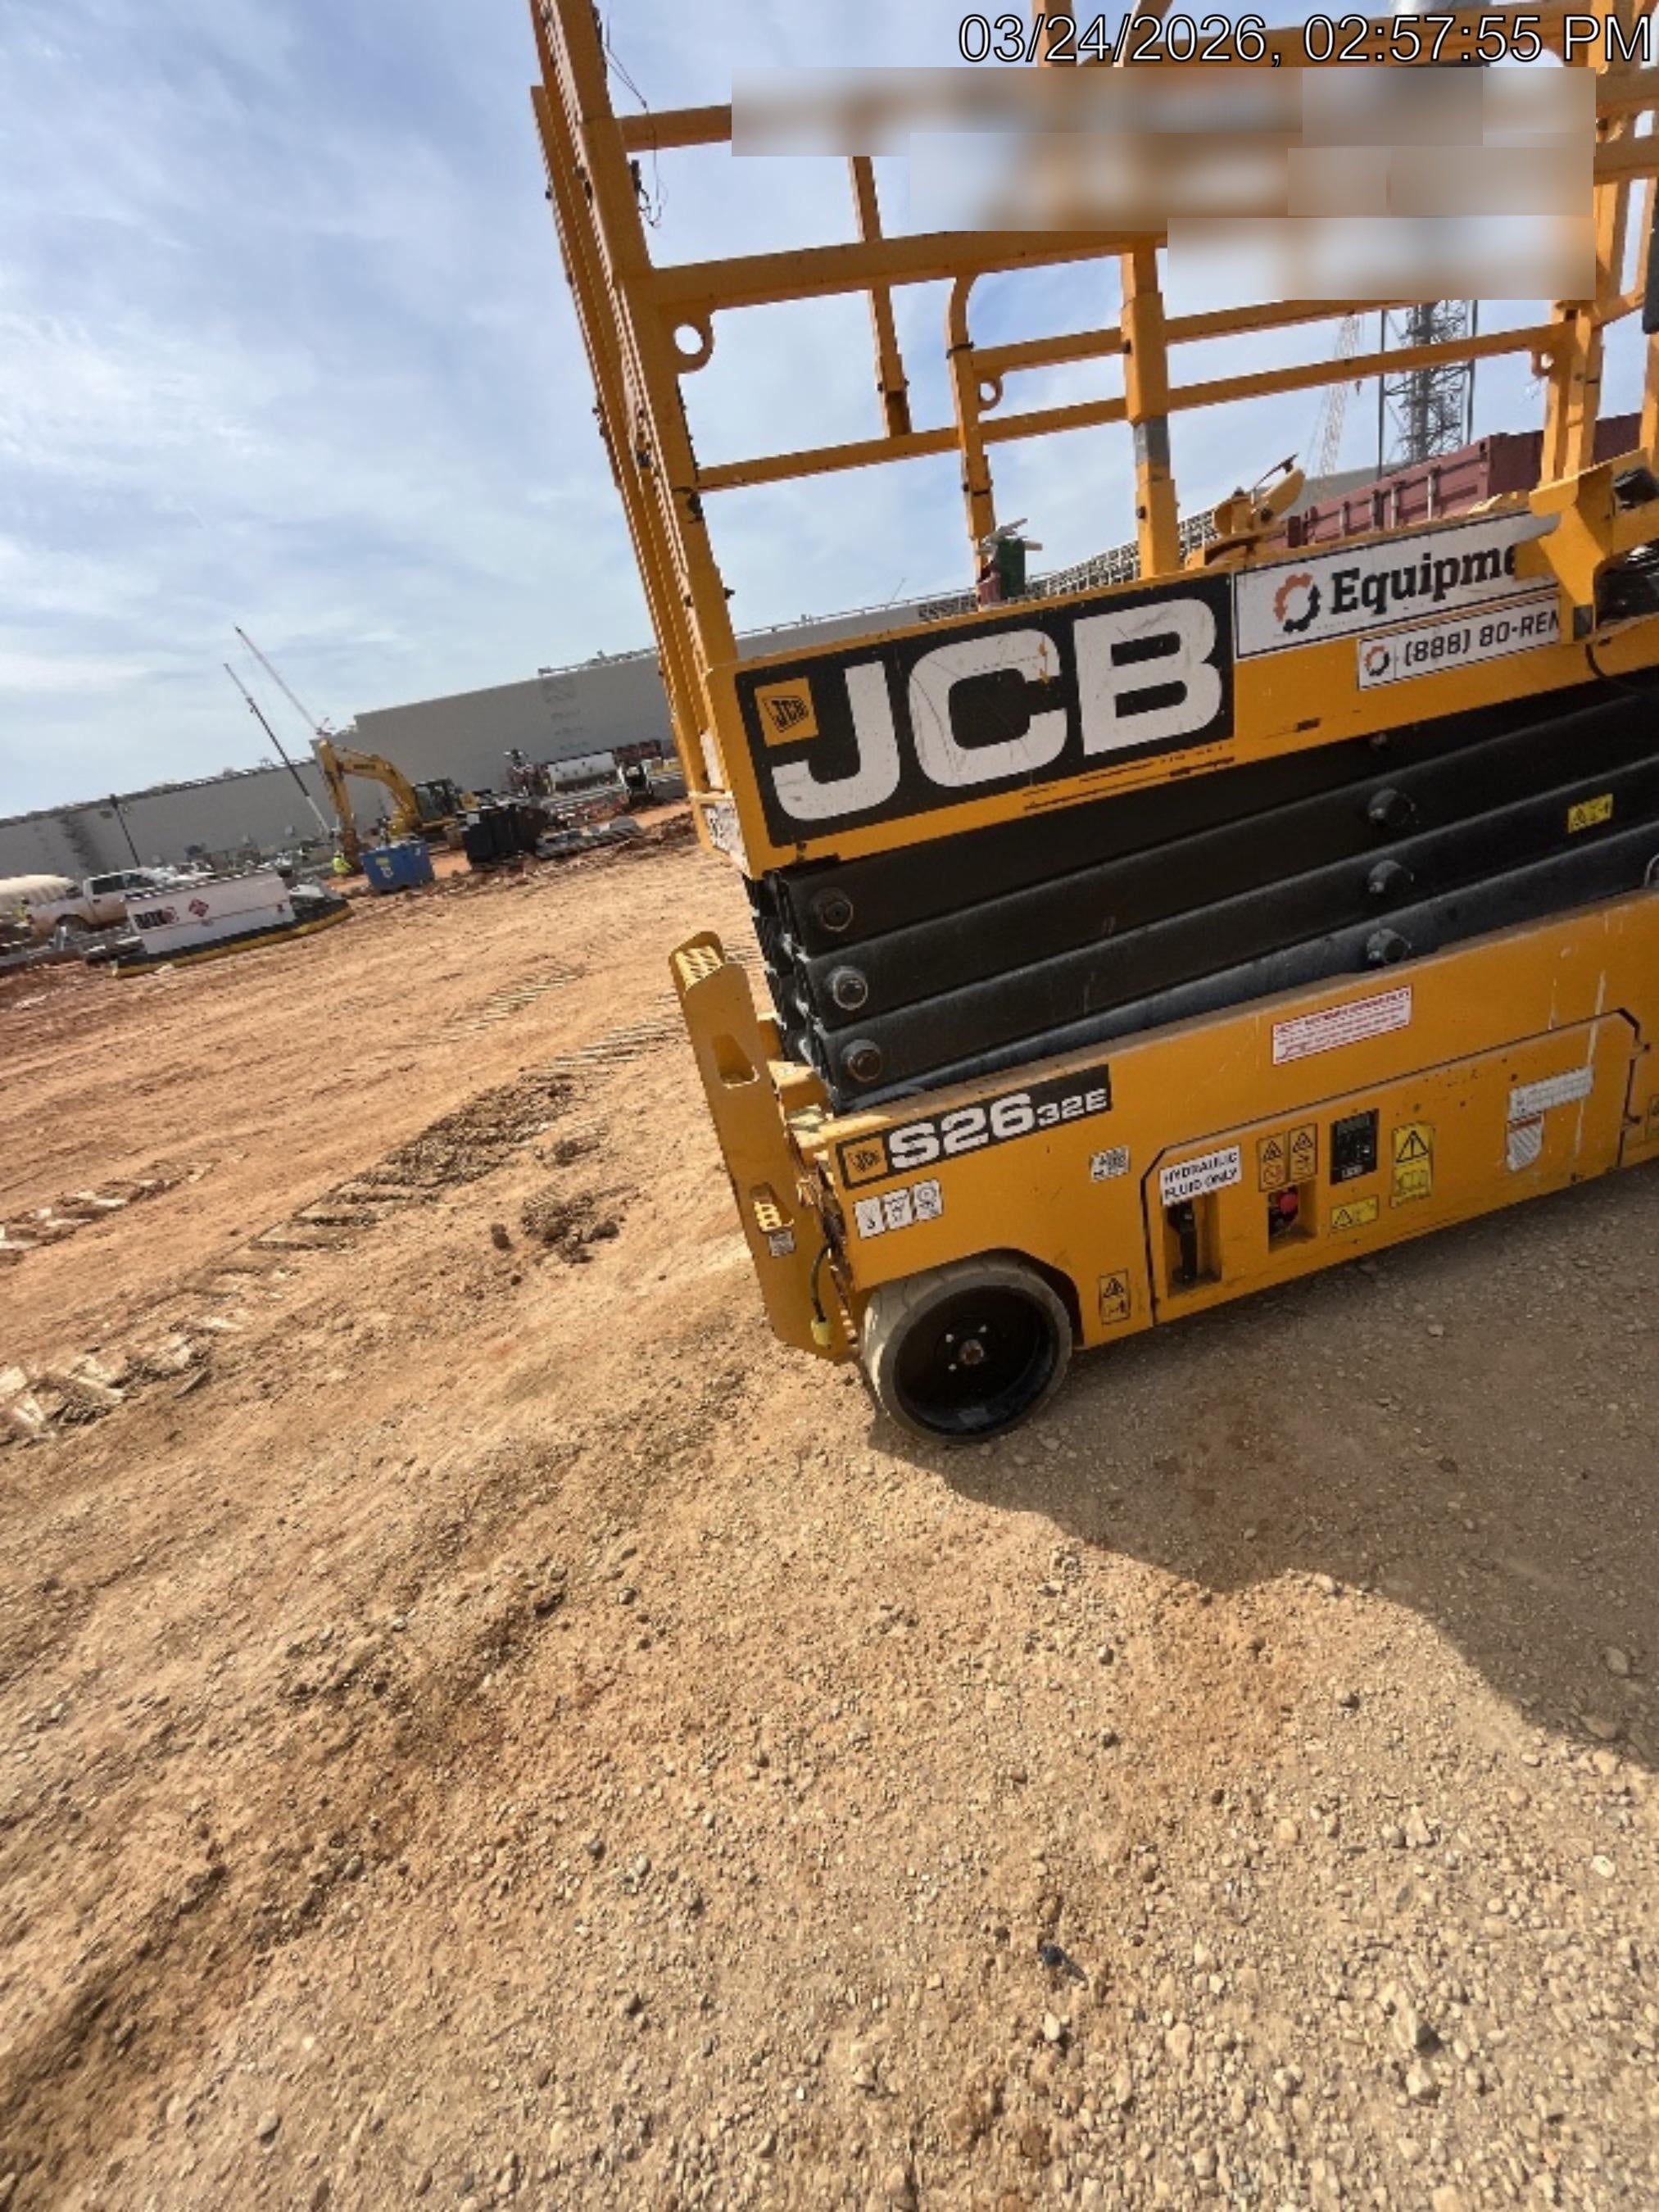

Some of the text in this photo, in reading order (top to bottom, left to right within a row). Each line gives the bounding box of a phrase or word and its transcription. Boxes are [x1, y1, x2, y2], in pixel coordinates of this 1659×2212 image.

[1404, 629, 1471, 668] (888)
[772, 599, 1222, 820] JCB
[1164, 1152, 1238, 1184] HYDRAULIC
[1164, 1167, 1238, 1200] FLUID ONLY
